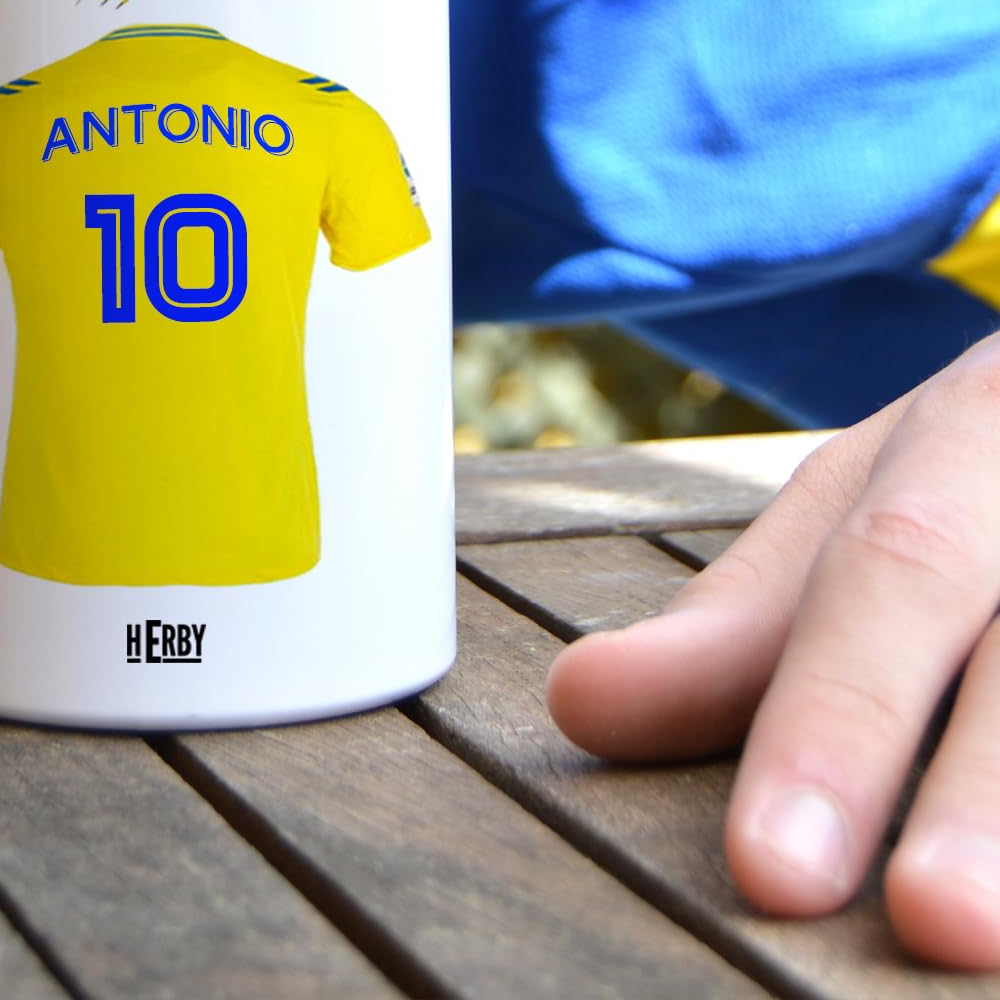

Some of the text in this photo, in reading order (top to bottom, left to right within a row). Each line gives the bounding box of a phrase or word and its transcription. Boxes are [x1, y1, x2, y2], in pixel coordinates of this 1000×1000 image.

[42, 103, 295, 163] ANTONIO
[85, 193, 248, 323] 10
[126, 619, 207, 663] HERBY
